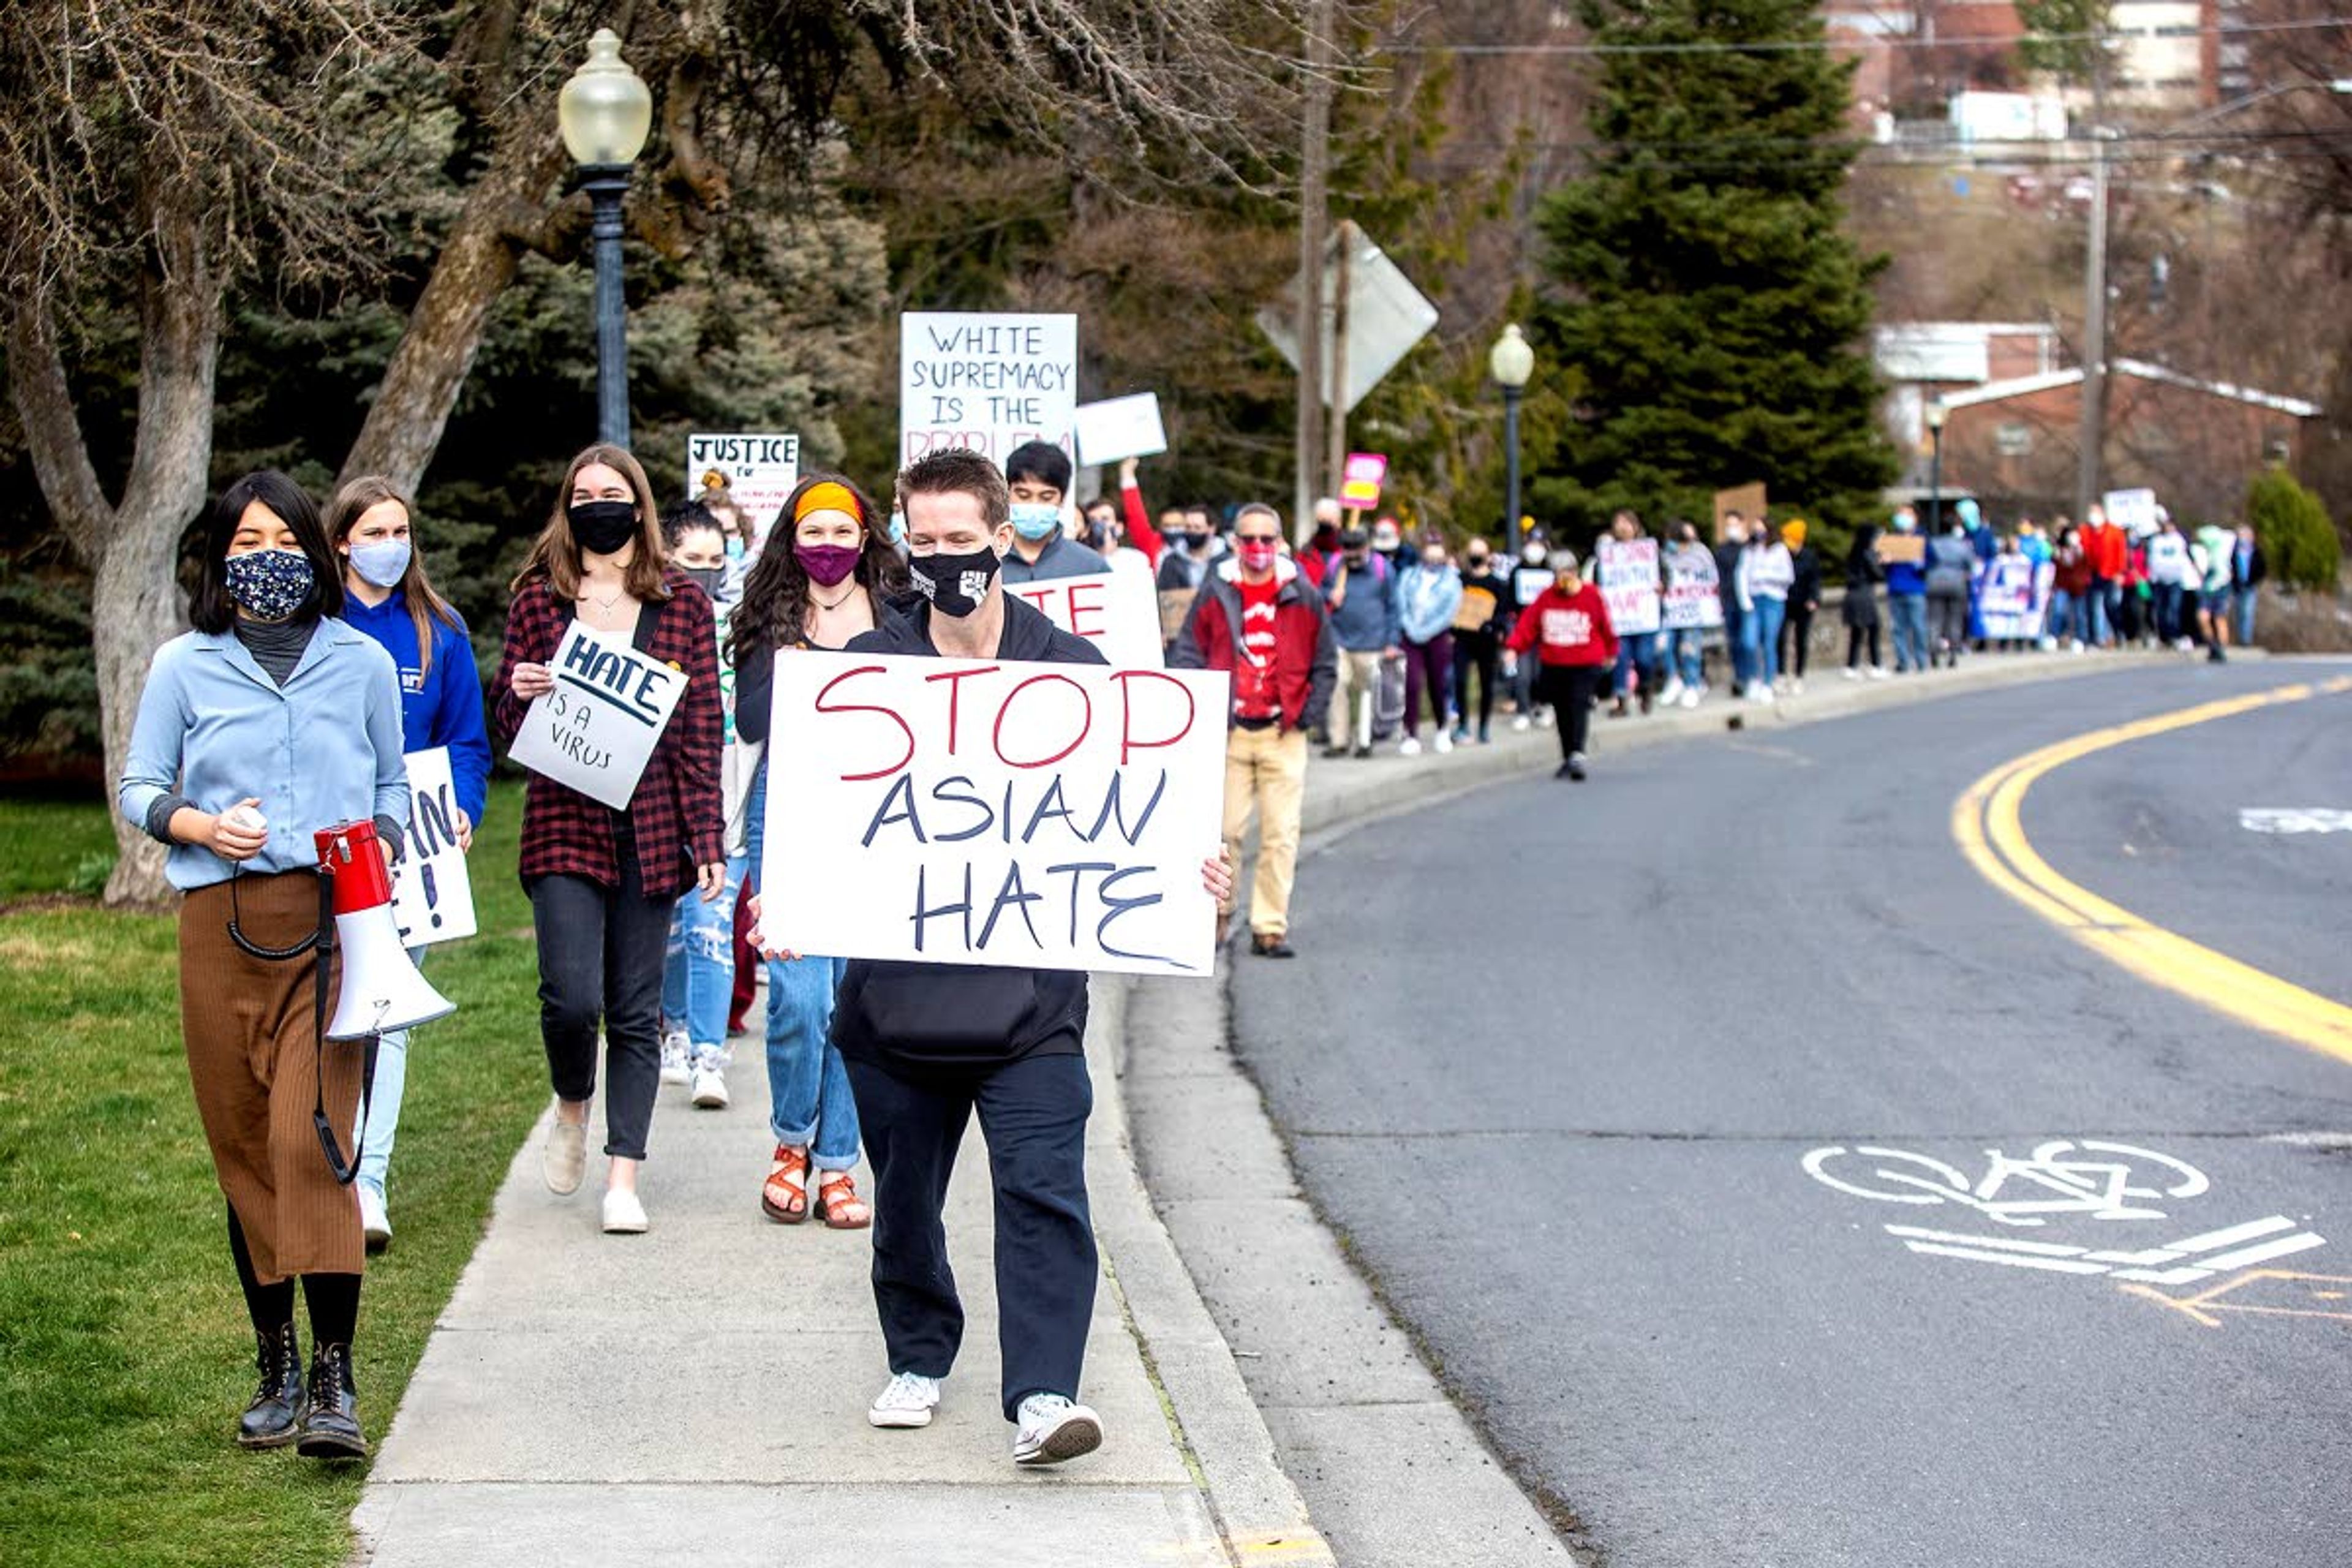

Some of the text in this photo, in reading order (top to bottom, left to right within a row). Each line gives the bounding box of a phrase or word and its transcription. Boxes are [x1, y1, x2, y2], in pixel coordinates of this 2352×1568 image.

[928, 325, 1042, 355] WHITE
[911, 360, 1071, 391] SUPREMACY
[930, 396, 1042, 424] IS THE
[693, 439, 796, 463] JUSTICE
[564, 633, 671, 715] HATE
[547, 688, 592, 730] IS A
[815, 666, 1194, 780] STOP
[552, 723, 612, 769] VIRUS
[861, 769, 1166, 848] ASIAN
[910, 859, 1198, 970] HATE
